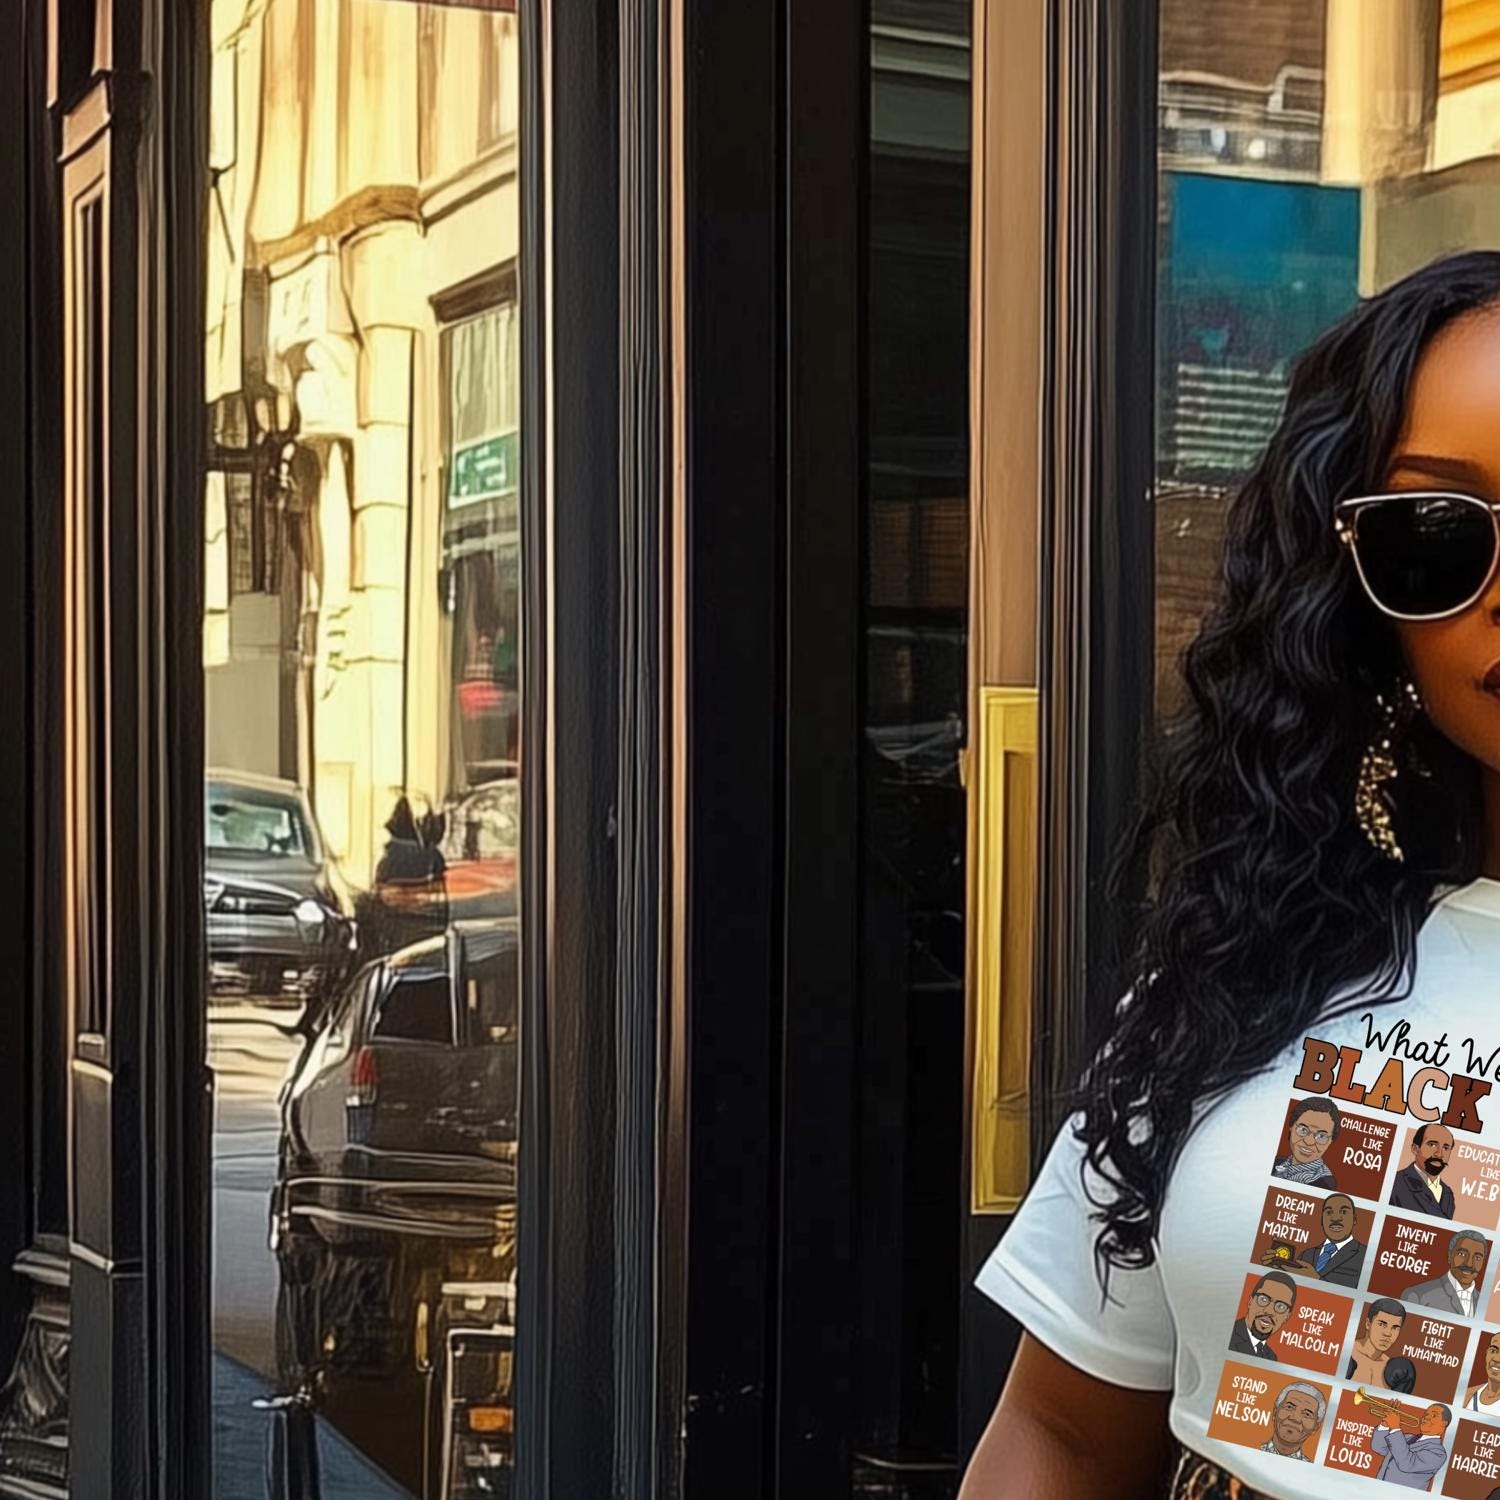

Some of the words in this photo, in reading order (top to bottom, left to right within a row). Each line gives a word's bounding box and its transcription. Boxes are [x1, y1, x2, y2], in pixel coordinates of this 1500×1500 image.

[1361, 1013, 1450, 1067] What
[1293, 1037, 1492, 1134] BLACK
[1340, 1117, 1391, 1139] CHALLENGE
[1362, 1137, 1383, 1151] LIKE
[1342, 1146, 1383, 1172] ROSA
[1461, 1177, 1500, 1202] W.E.B
[1275, 1193, 1315, 1216] DREAM
[1277, 1210, 1298, 1225] LIKE
[1262, 1219, 1309, 1244] MARTIN
[1395, 1223, 1438, 1246] INVENT
[1398, 1240, 1418, 1255] LIKE
[1379, 1250, 1431, 1276] GEORGE
[1298, 1305, 1335, 1326] SPEAK
[1302, 1321, 1324, 1336] LIKE
[1421, 1320, 1454, 1339] FIGHT
[1279, 1329, 1340, 1357] MALCOLM
[1423, 1336, 1445, 1350] LIKE
[1402, 1344, 1459, 1368] MUHAMMAD
[1232, 1375, 1268, 1394] STAND
[1235, 1391, 1257, 1406] LIKE
[1215, 1399, 1271, 1427] NELSON
[1336, 1418, 1375, 1438] INSPIRE
[1342, 1433, 1364, 1447] LIKE
[1329, 1445, 1373, 1470] LOUIS
[1474, 1446, 1495, 1460] LIKE
